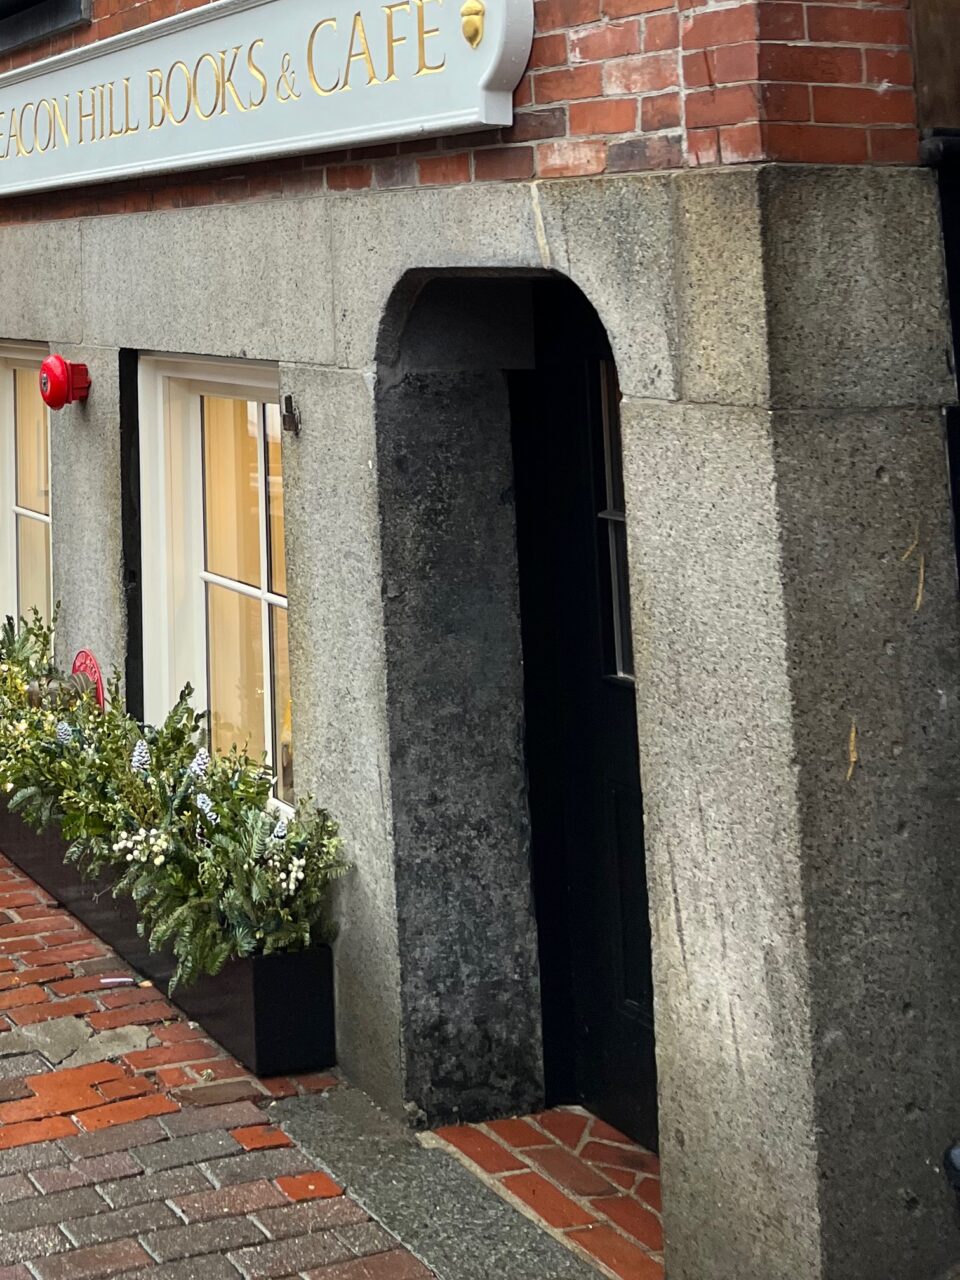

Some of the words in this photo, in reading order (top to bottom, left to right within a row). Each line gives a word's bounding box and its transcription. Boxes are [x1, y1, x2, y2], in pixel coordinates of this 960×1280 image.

[77, 77, 139, 145] HILL
[147, 38, 268, 131] BOOKS
[276, 53, 302, 103] &
